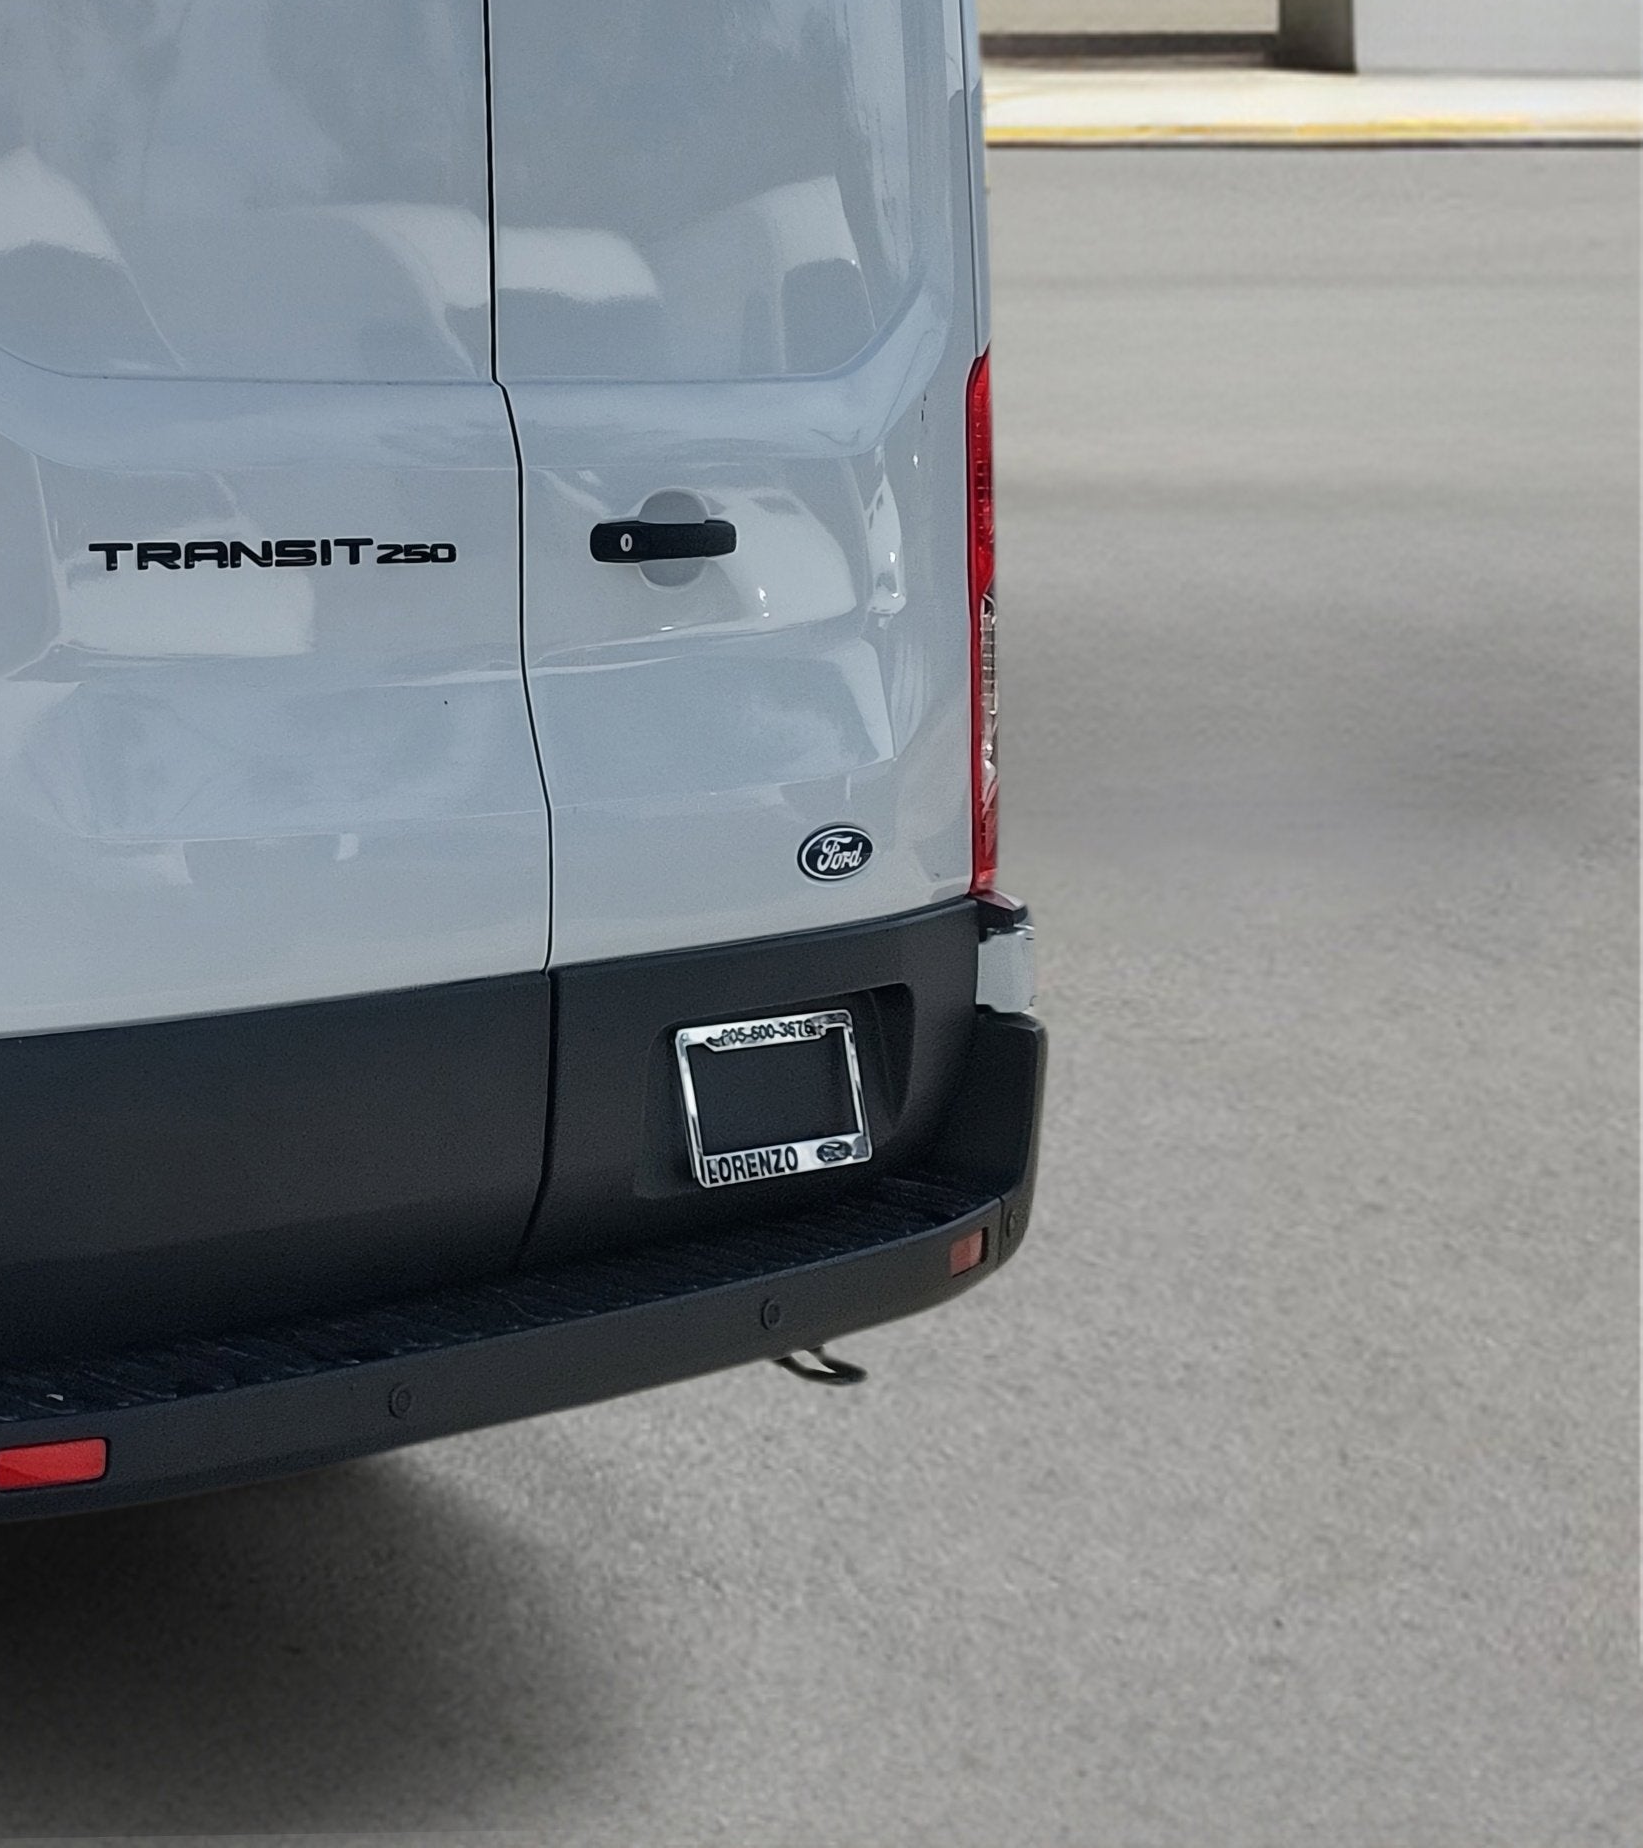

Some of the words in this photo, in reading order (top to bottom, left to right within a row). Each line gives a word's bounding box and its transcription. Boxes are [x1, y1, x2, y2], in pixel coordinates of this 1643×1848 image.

[88, 537, 374, 572] TRANSIT
[376, 542, 458, 565] 250
[816, 836, 863, 872] Ford
[706, 1145, 799, 1185] LORENZO
